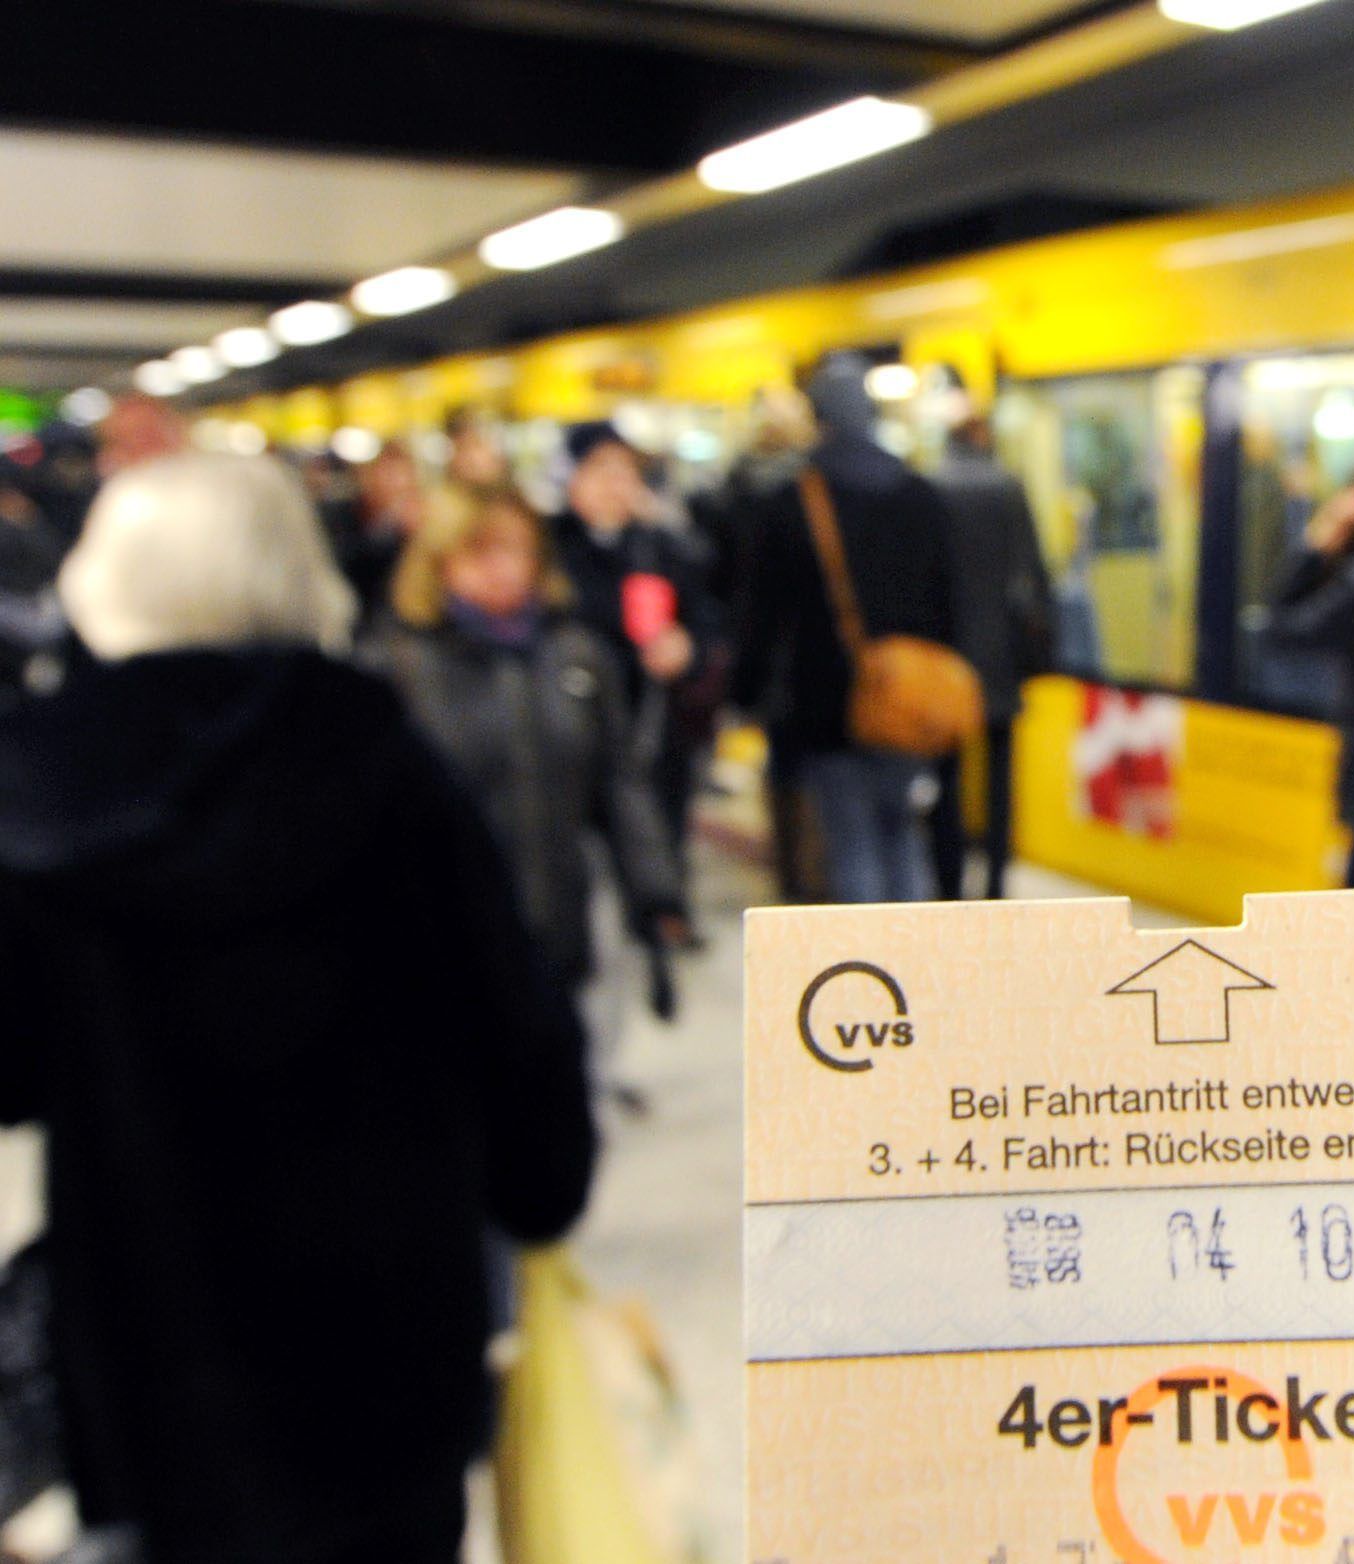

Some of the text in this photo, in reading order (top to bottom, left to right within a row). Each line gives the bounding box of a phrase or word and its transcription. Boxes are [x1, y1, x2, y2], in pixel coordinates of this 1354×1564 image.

[951, 1088, 1007, 1119] Bei
[1025, 1081, 1228, 1116] Fahrtantritt
[870, 1144, 901, 1175] 3.
[919, 1151, 939, 1171] +
[955, 1140, 986, 1170] 4.
[1004, 1137, 1108, 1169] Fahrt:
[1127, 1131, 1309, 1165] Rückseite
